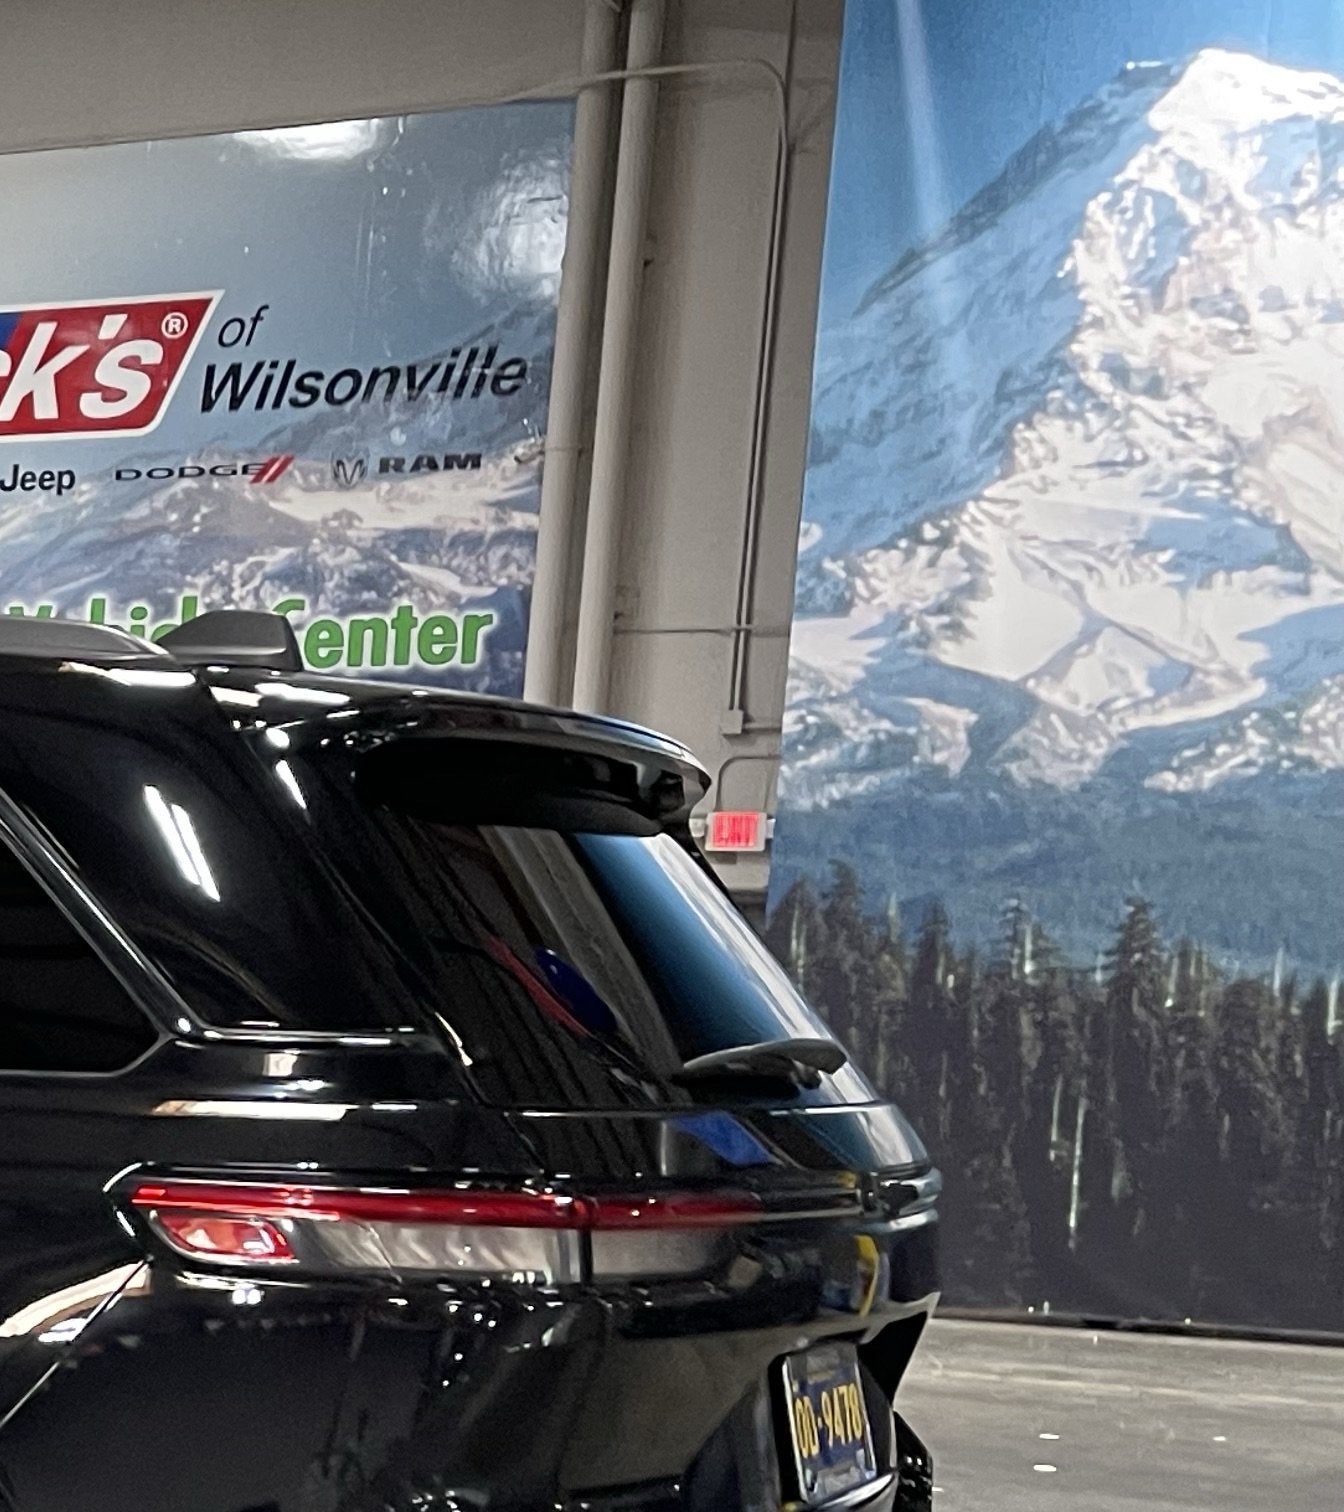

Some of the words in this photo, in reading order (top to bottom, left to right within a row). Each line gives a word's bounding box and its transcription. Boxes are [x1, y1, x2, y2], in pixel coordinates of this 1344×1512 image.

[217, 305, 269, 347] of
[200, 343, 528, 413] Wilsonville
[115, 462, 272, 482] DODGE
[378, 453, 482, 474] RAM
